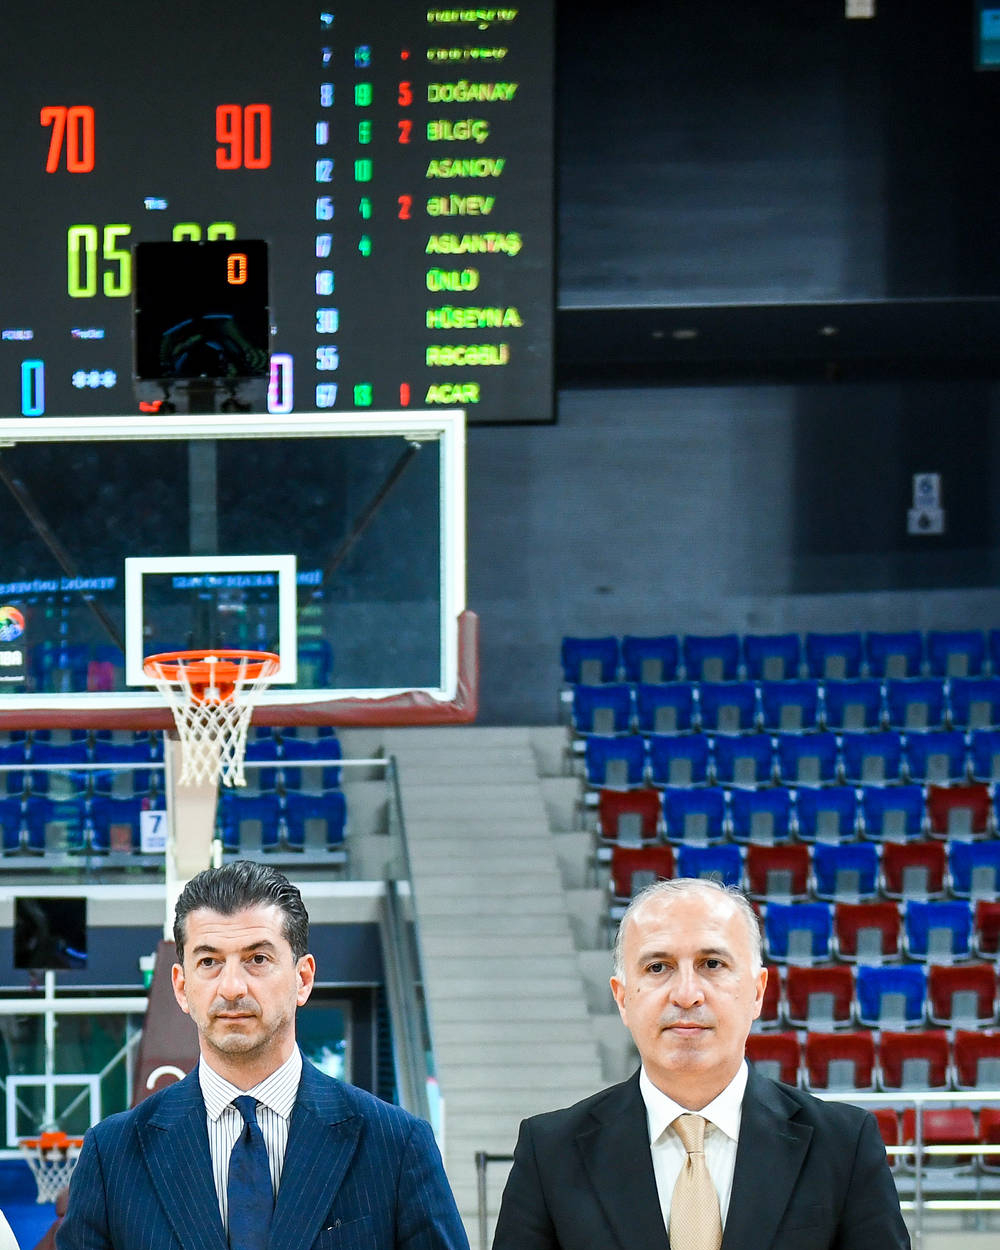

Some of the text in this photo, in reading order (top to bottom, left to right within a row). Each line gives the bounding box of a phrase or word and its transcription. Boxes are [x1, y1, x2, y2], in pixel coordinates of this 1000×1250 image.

[398, 81, 413, 106] 5
[428, 80, 518, 102] DOĞANAY
[40, 105, 95, 173] 70
[216, 104, 271, 170] 90
[398, 120, 412, 144] 2
[398, 195, 412, 220] 2
[427, 194, 495, 216] ƏLİYEV
[68, 224, 132, 298] 05
[227, 253, 247, 284] 0
[21, 359, 45, 416] 0
[268, 353, 294, 412] 0
[400, 383, 410, 406] 1
[149, 815, 161, 833] 7
